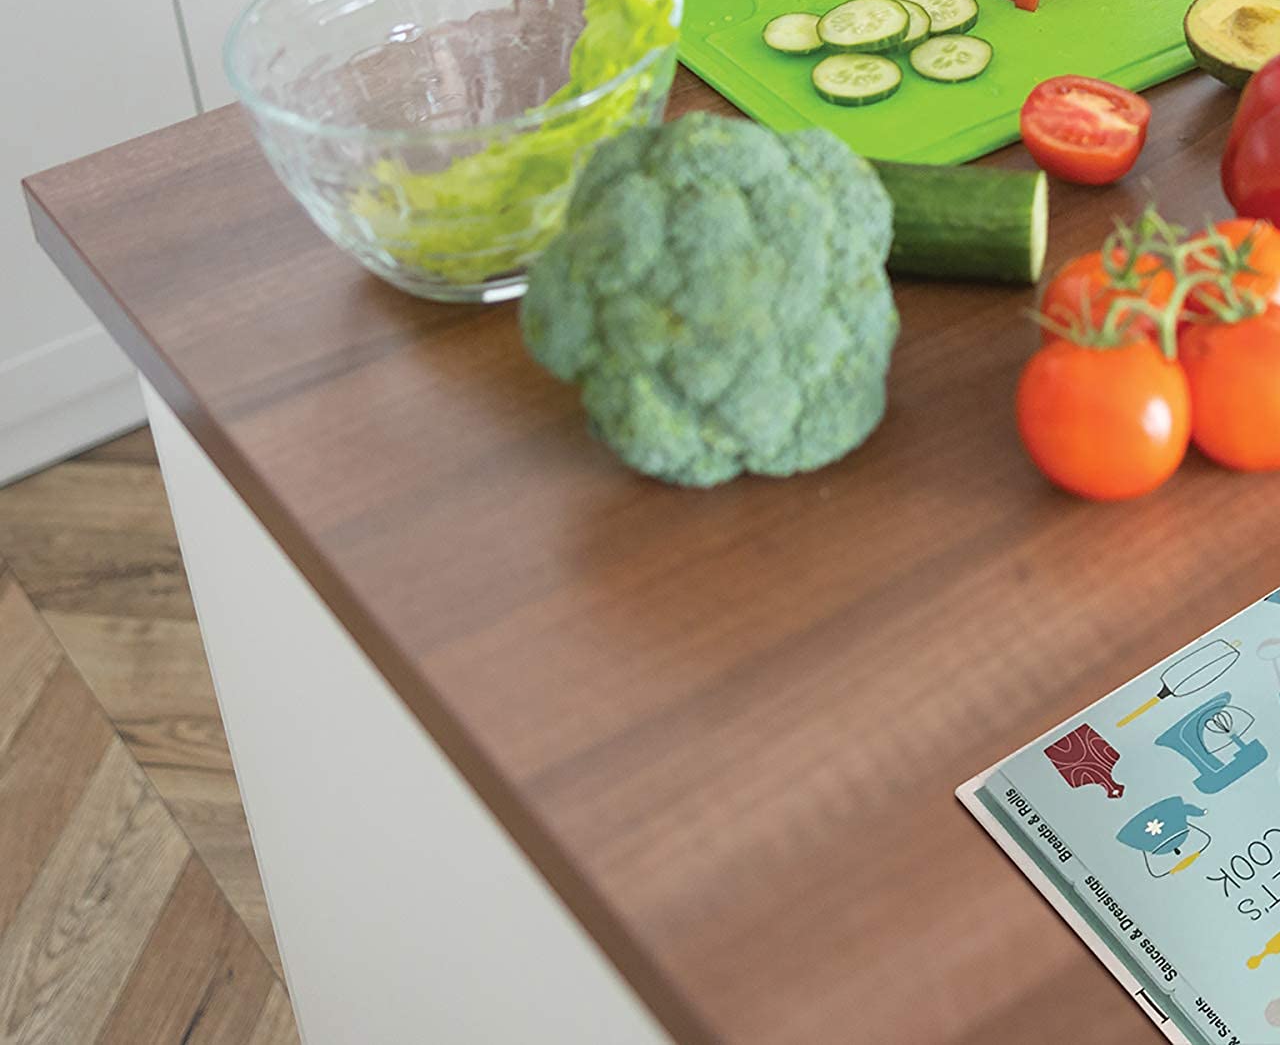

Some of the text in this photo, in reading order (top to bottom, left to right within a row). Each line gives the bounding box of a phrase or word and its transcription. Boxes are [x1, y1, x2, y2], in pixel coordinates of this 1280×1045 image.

[1005, 788, 1072, 863] Breads & Rolls
[1084, 875, 1177, 982] Sauces & Dressings
